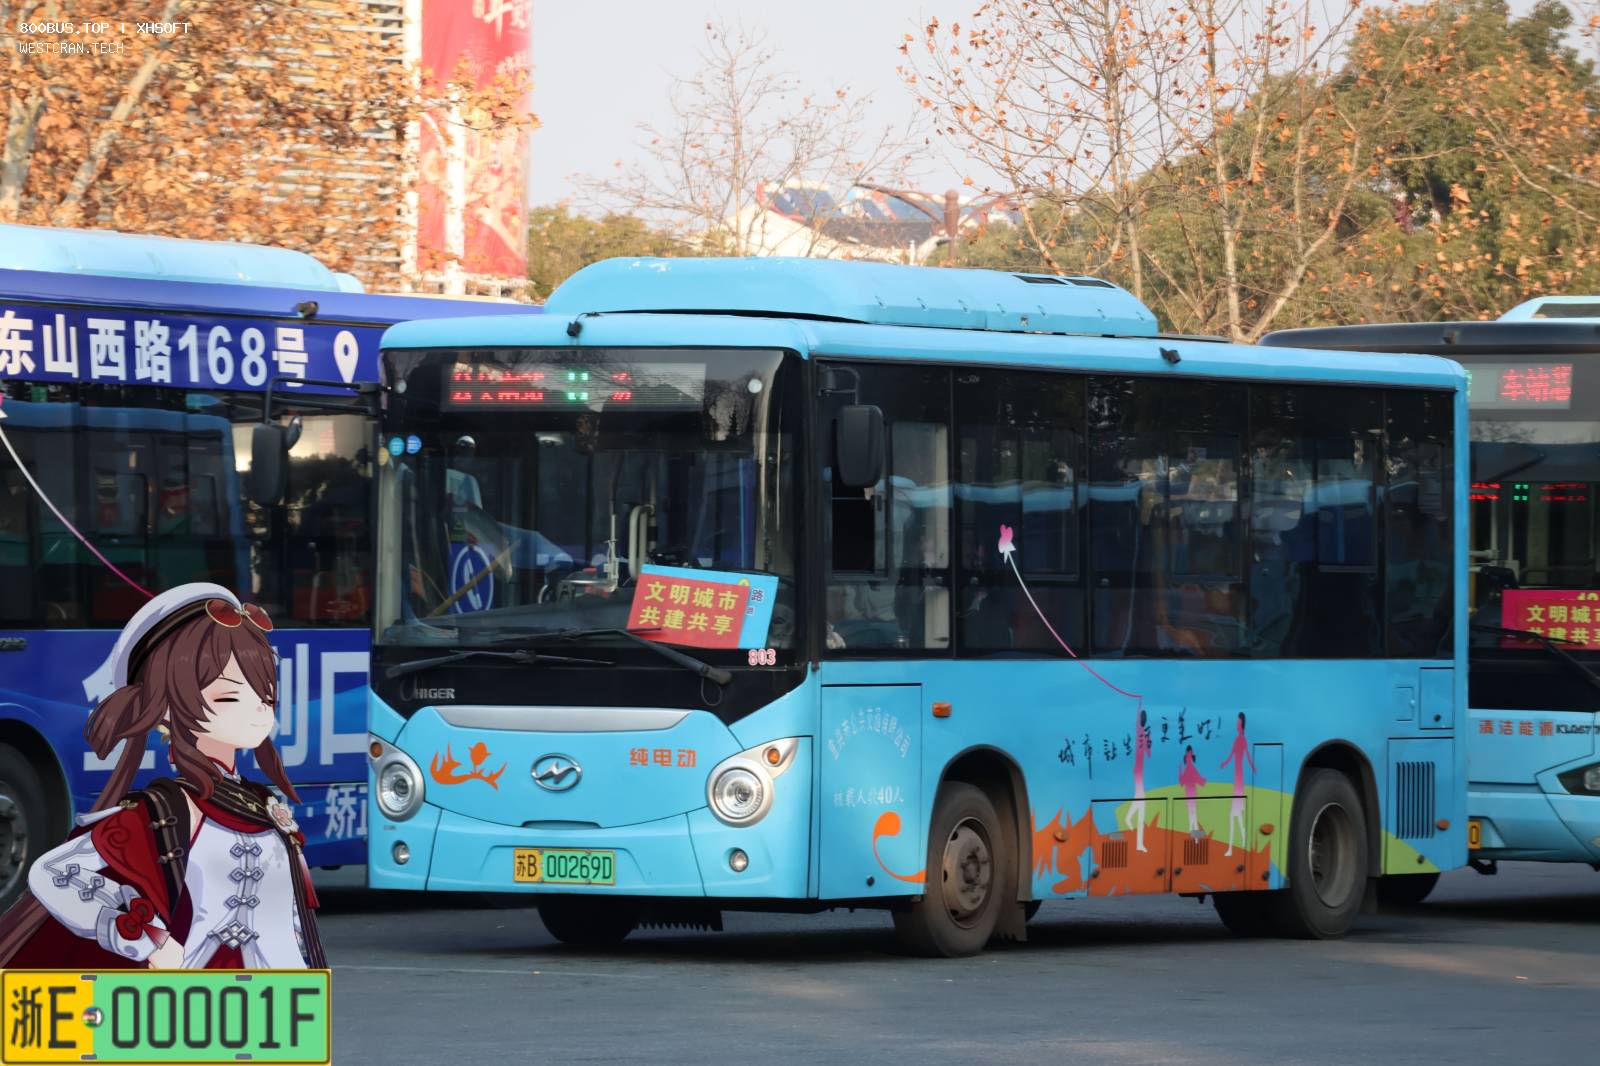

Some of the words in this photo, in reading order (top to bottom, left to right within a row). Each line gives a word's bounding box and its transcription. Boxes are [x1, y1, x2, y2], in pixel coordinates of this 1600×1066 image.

[0, 310, 308, 387] 东山西路168号
[644, 581, 739, 611] 文明城市
[639, 606, 734, 635] 共建共享
[748, 649, 776, 666] 803
[415, 688, 455, 699] HIGER
[630, 747, 696, 768] 纯电动
